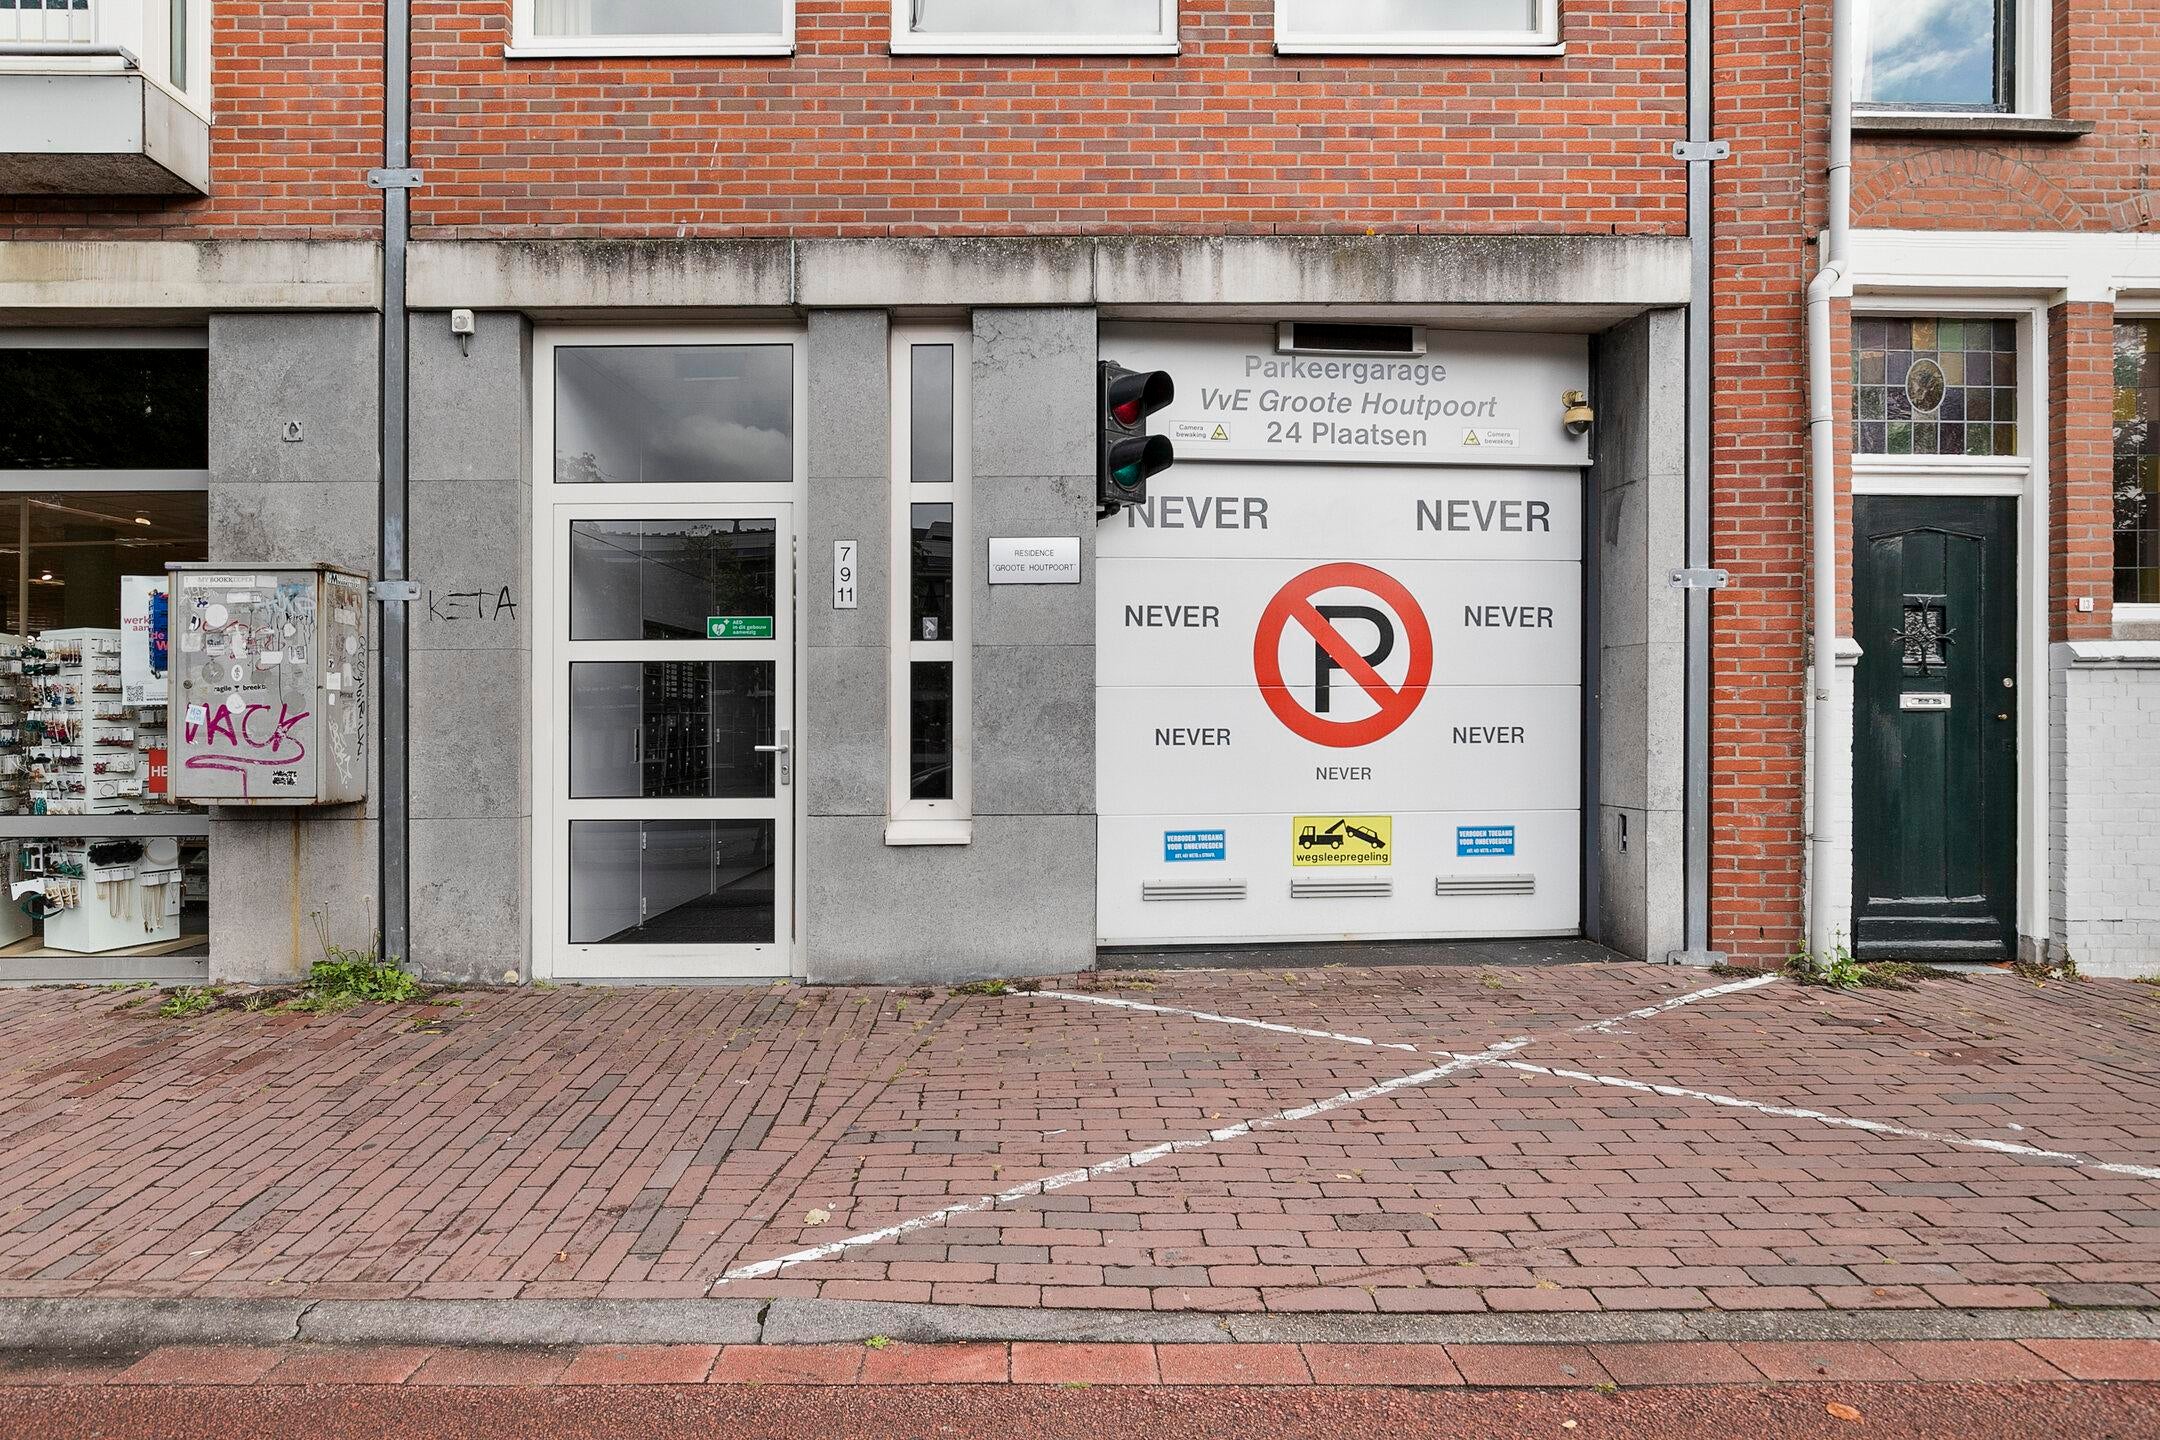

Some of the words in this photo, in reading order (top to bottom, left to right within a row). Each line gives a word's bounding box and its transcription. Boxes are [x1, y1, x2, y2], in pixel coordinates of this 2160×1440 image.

[1244, 355, 1447, 385] Parkeergarage
[1201, 388, 1251, 411] VvE
[1258, 389, 1353, 413] Groote
[1361, 392, 1498, 420] Houtpoort
[1267, 421, 1303, 443] 24
[1312, 421, 1428, 446] Plaatsen
[1128, 496, 1269, 529] NEVER
[1417, 500, 1550, 532] NEVER
[840, 546, 851, 562] 7
[1014, 549, 1055, 557] RESIDENCE
[840, 566, 851, 582] 9
[837, 587, 853, 602] 11
[124, 616, 150, 624] werk
[1125, 605, 1219, 628] NEVER
[1465, 606, 1554, 628] NEVER
[1156, 729, 1231, 746] NEVER
[1453, 726, 1525, 744] NEVER
[1316, 767, 1372, 780] NEVER
[1297, 852, 1388, 862] wegsleepregeling
